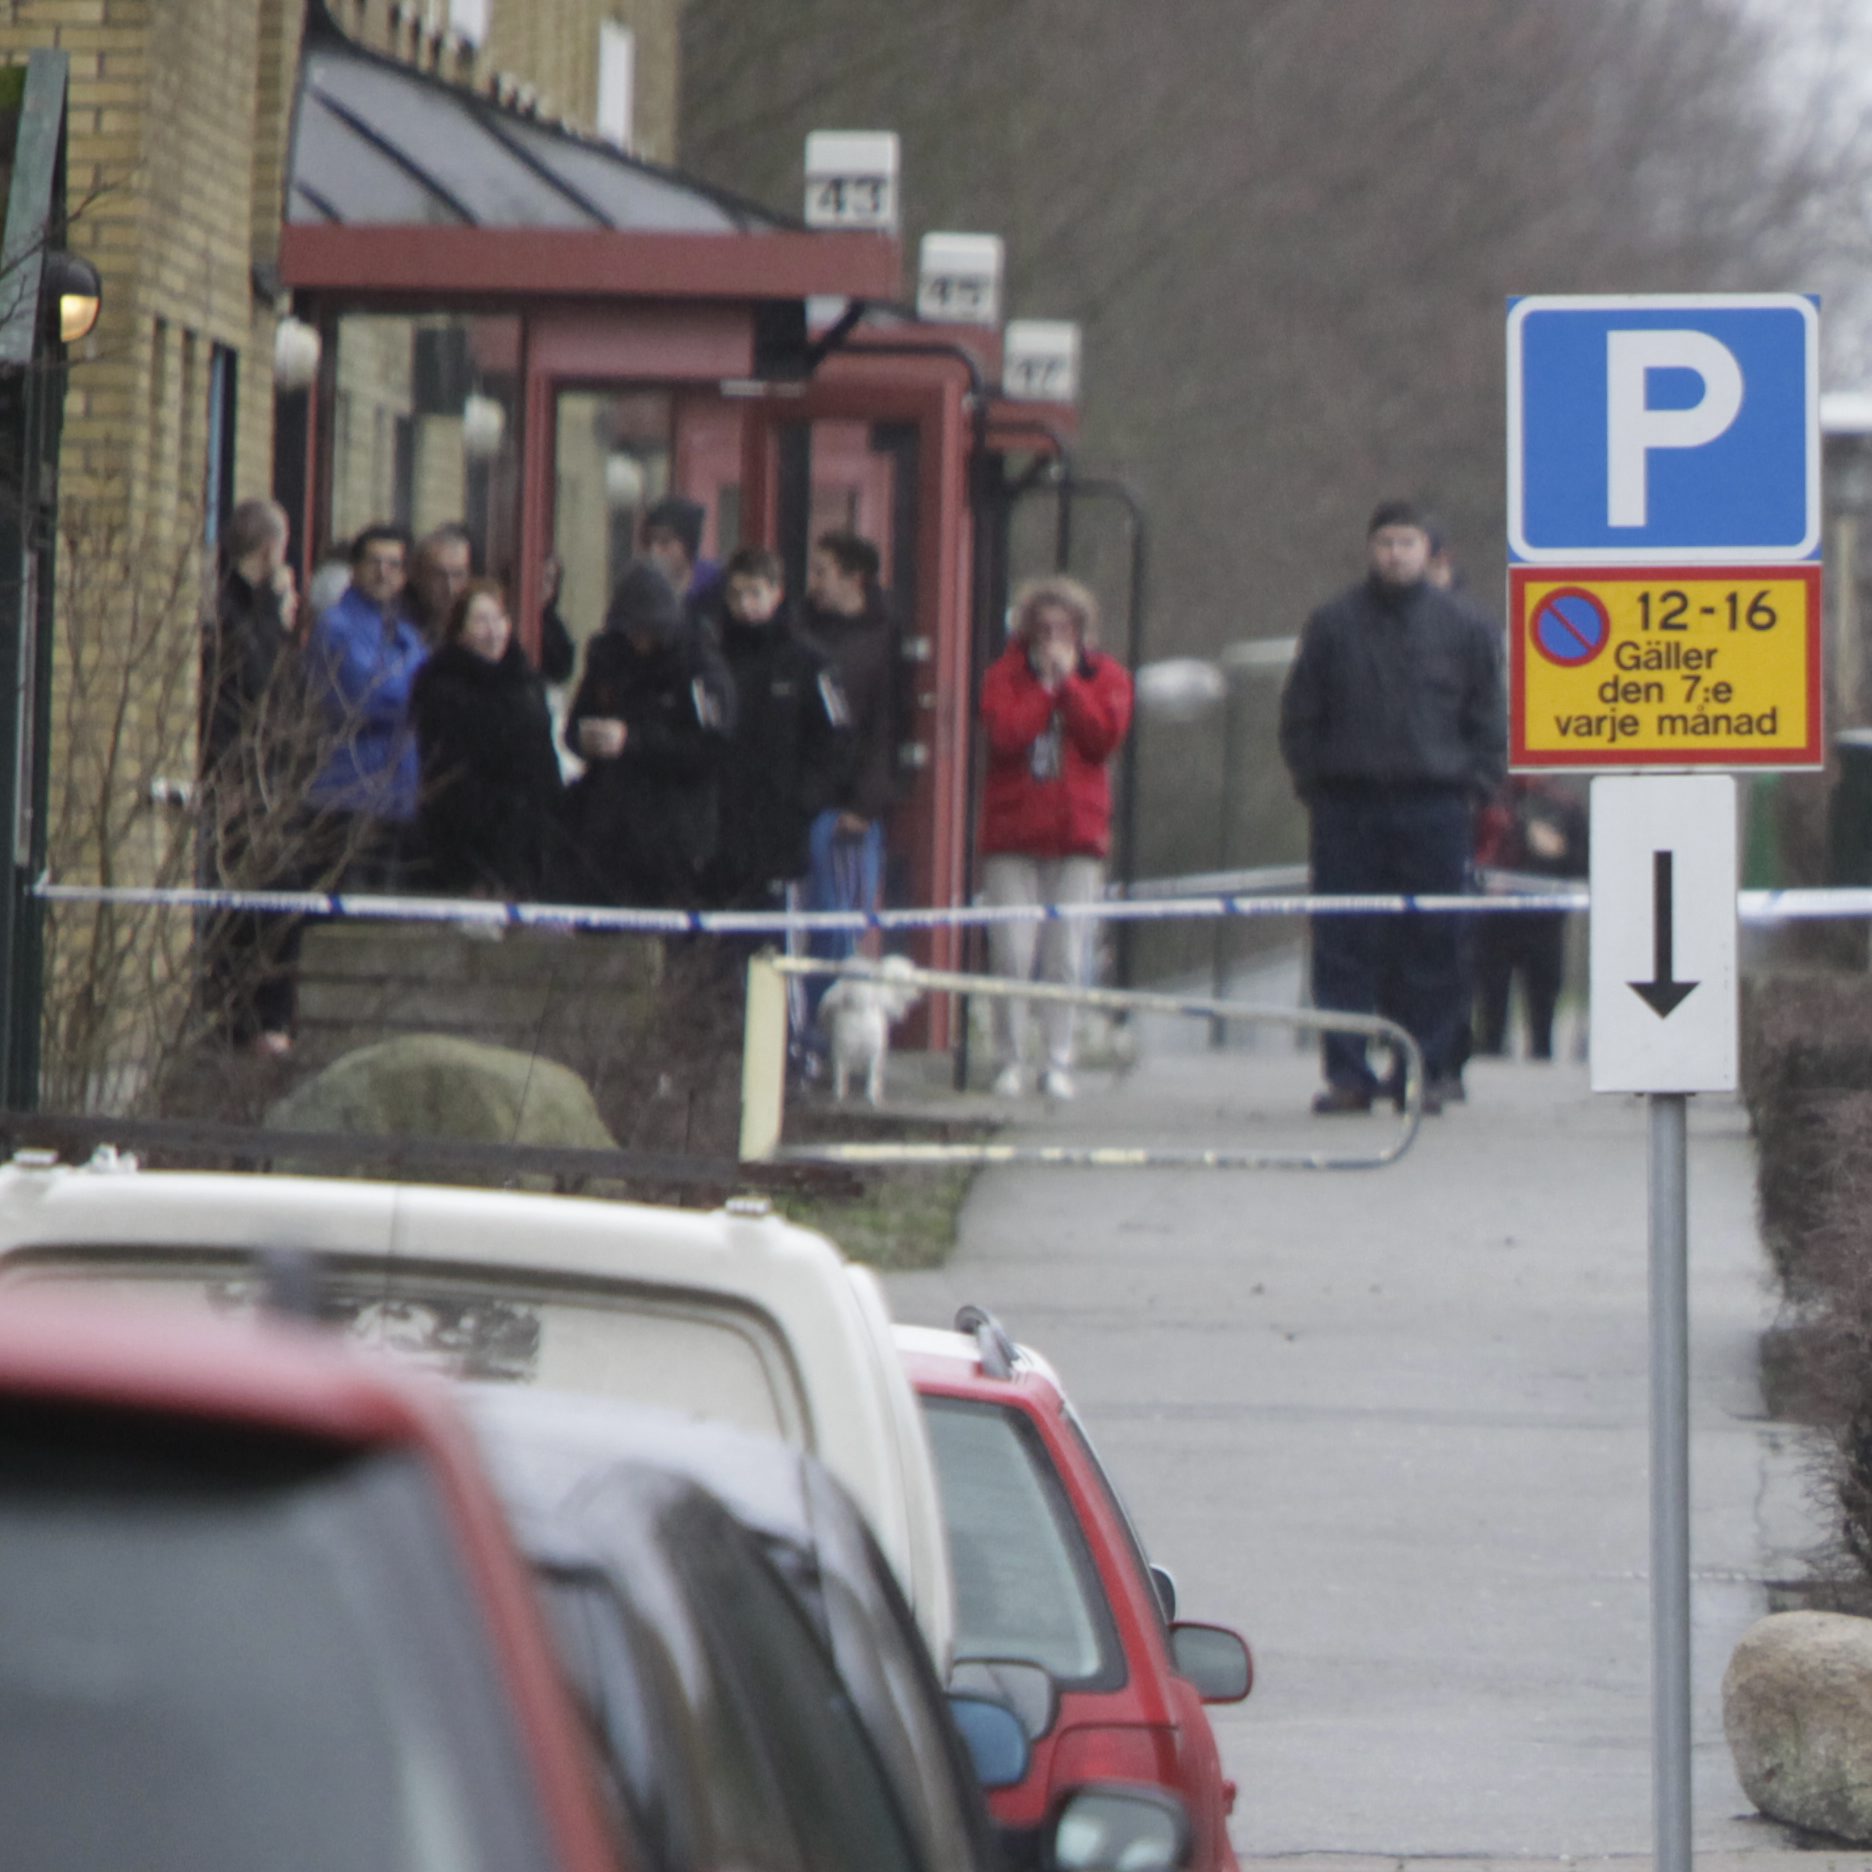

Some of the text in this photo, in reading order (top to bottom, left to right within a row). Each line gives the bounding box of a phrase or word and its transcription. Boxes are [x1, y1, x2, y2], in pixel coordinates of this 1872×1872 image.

[815, 175, 886, 217] 43
[1607, 329, 1744, 527] P
[1637, 589, 1777, 632] 12-16
[1614, 640, 1719, 672] Gäller
[1598, 674, 1734, 704] den 7:e
[1554, 703, 1779, 744] varje månad
